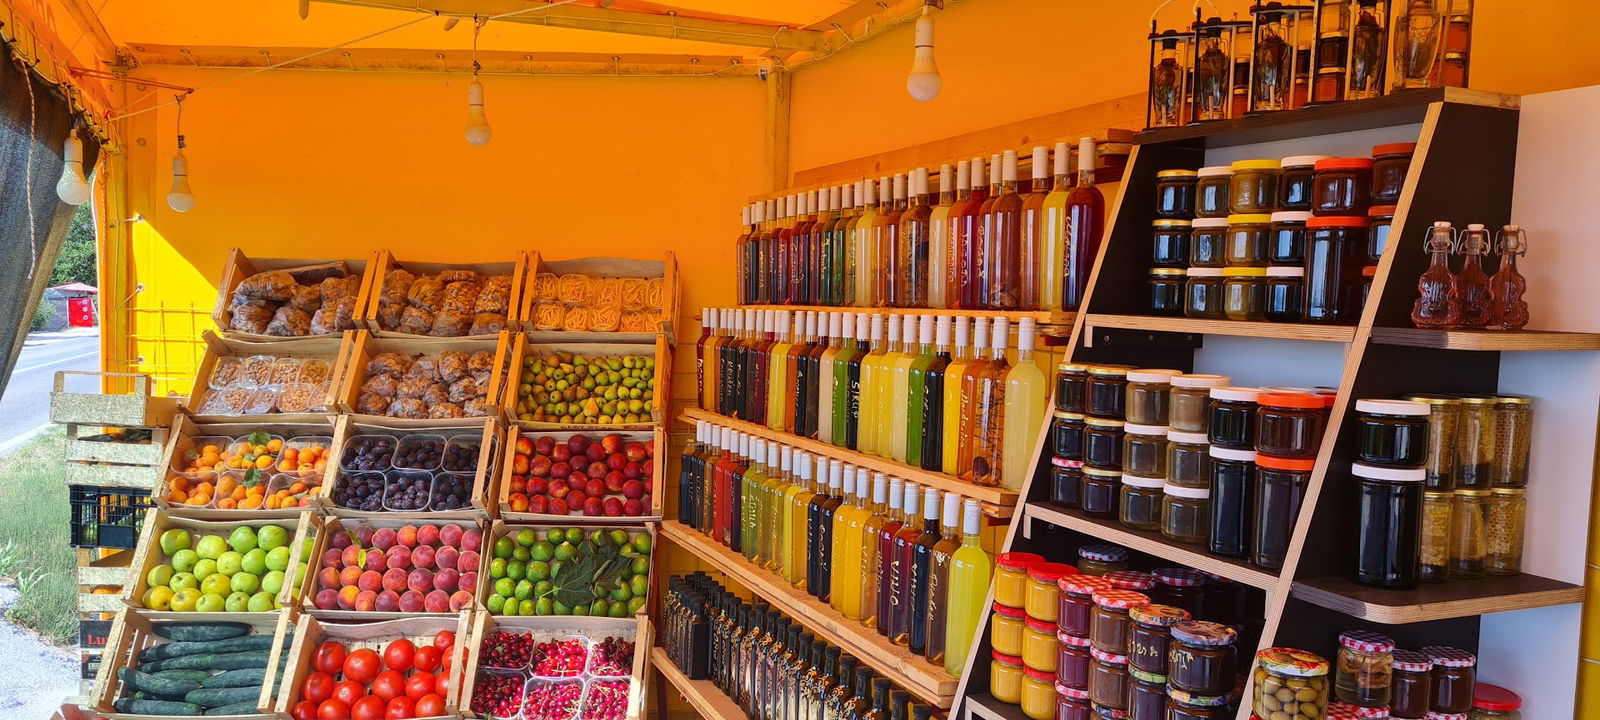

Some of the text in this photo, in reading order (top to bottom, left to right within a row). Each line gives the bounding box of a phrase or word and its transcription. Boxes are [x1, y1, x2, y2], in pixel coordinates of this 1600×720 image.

[850, 380, 860, 419] SIRUP
[888, 560, 900, 607] VINO
[87, 634, 109, 646] Lu
